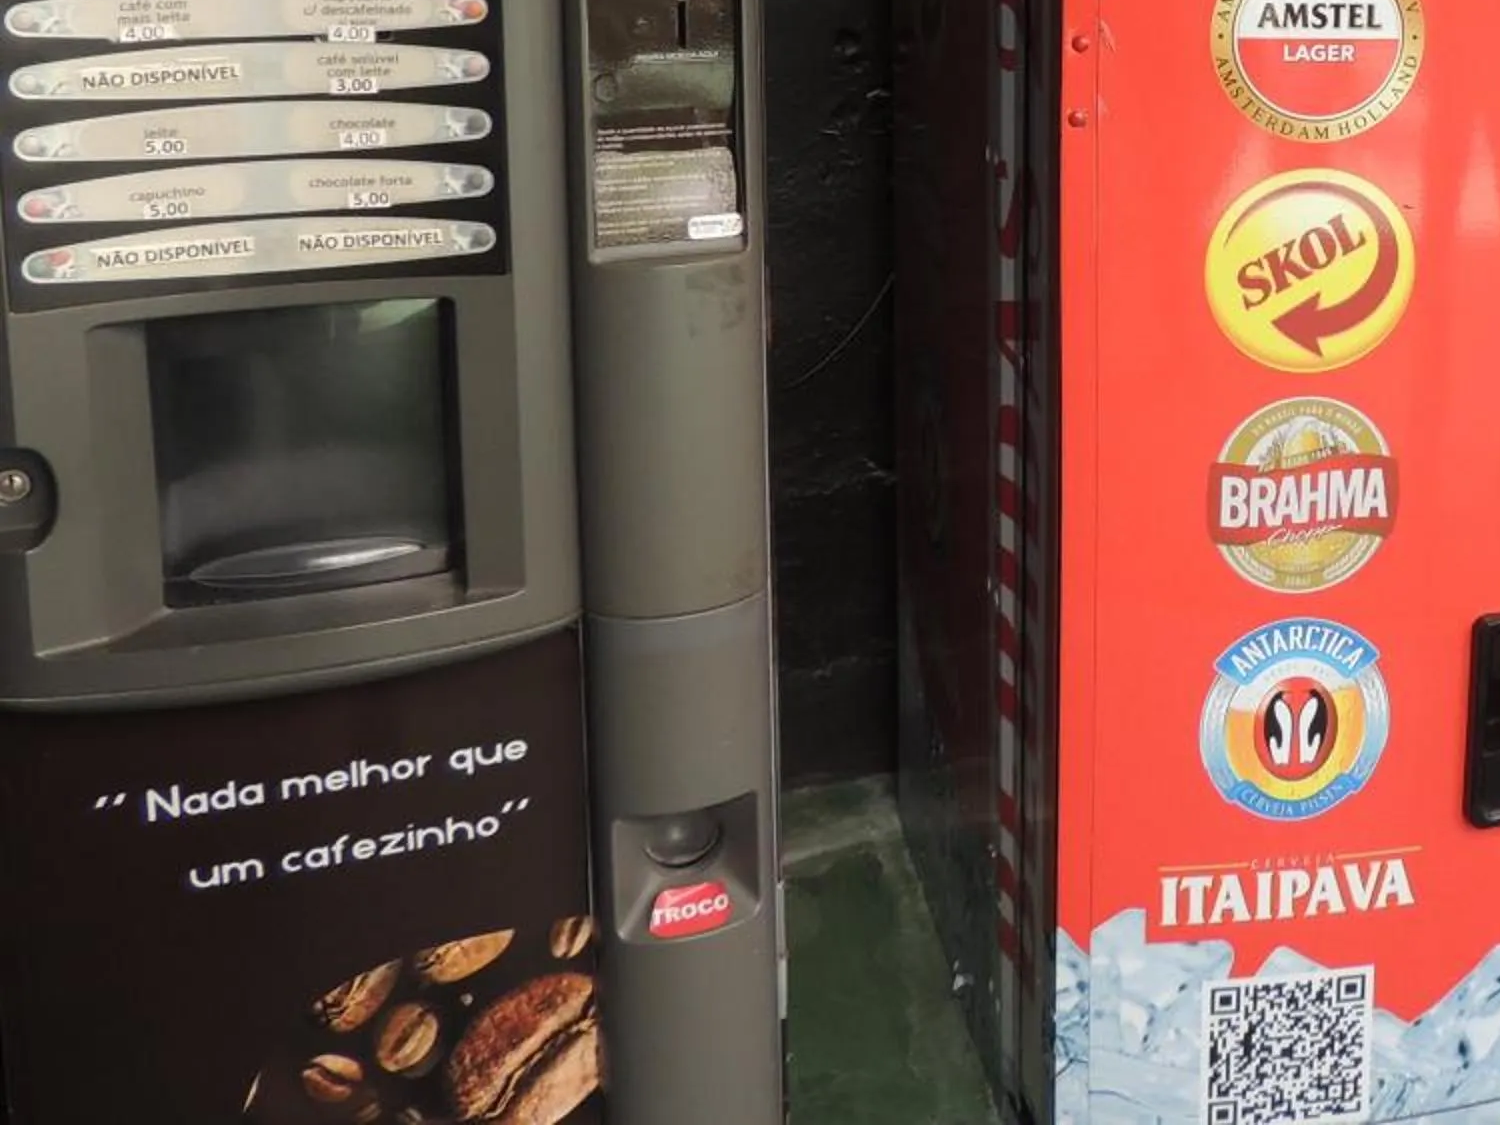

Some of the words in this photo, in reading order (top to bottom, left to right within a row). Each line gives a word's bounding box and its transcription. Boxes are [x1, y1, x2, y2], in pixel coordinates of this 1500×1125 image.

[119, 0, 151, 12] café
[1257, 2, 1383, 30] AMSTEL
[316, 53, 347, 66] café
[1283, 44, 1355, 62] LAGER
[82, 73, 126, 90] NÃO
[130, 65, 240, 87] DISPONÍVEL
[1216, 55, 1330, 140] AMSTERDAM
[1338, 55, 1417, 136] HOLLAND
[329, 117, 396, 130] chocolate
[308, 176, 376, 189] chocolate
[298, 234, 339, 251] NÃO
[343, 229, 443, 249] DISPONÍVEL
[97, 249, 139, 268] NÃO
[1236, 213, 1366, 311] SKOL
[1219, 467, 1388, 528] BRAHMA
[1231, 625, 1364, 677] ANTARCTICA
[145, 780, 265, 823] Nada
[280, 754, 432, 802] melhor
[448, 737, 529, 777] que
[190, 854, 264, 890] um
[1250, 854, 1336, 871] CERVEJA
[1160, 858, 1415, 927] ITAIPAVA
[651, 891, 730, 927] TROCO
